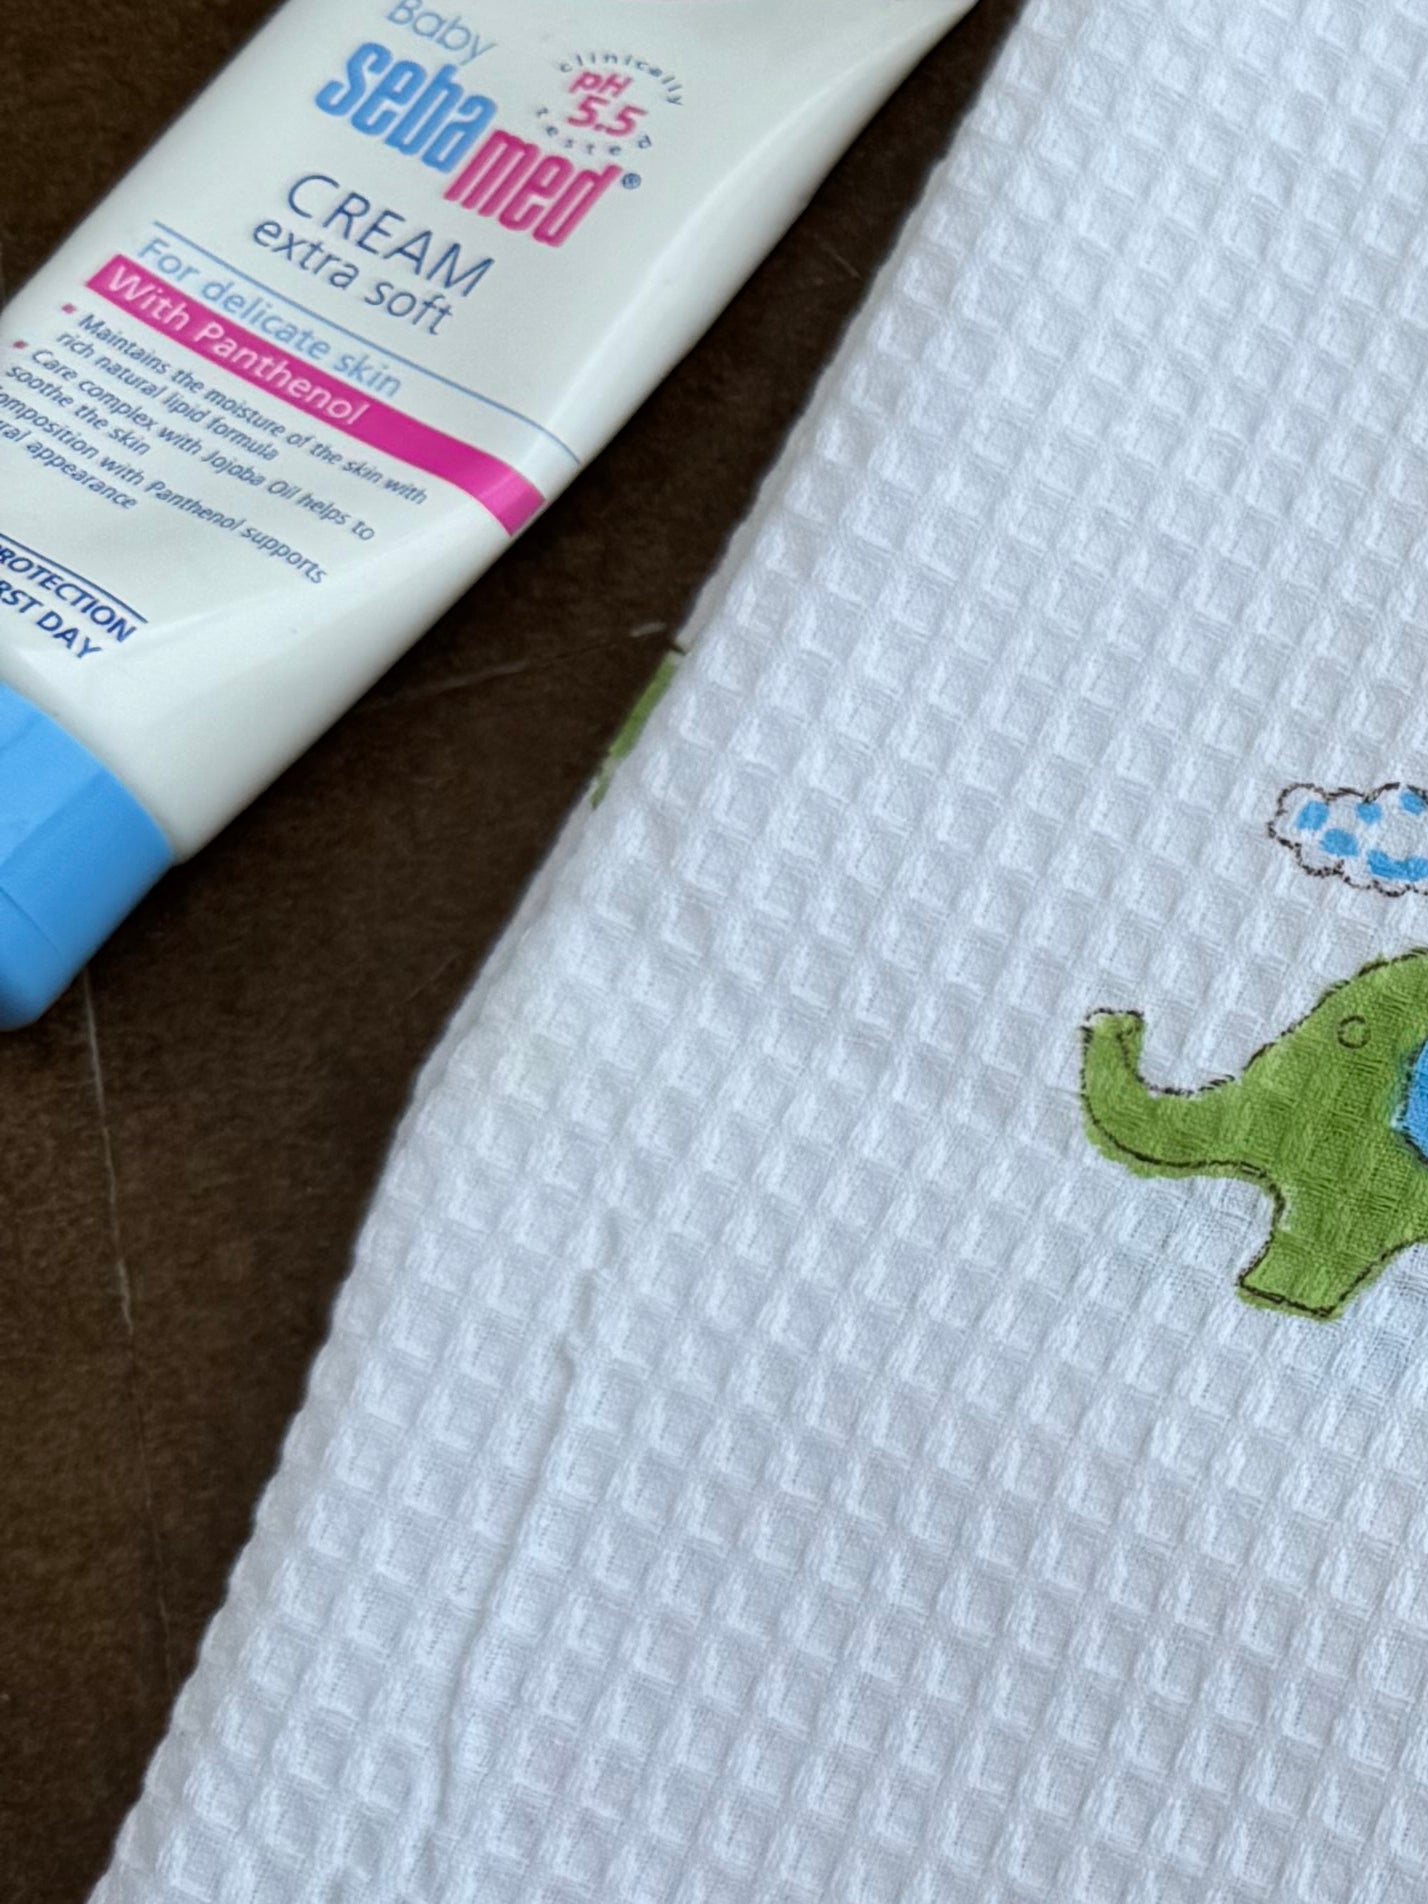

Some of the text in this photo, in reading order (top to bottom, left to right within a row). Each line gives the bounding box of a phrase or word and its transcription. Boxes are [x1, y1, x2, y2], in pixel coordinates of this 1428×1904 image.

[536, 107, 652, 155] tested
[559, 52, 683, 106] clinically
[567, 96, 649, 136] 5.5
[568, 71, 634, 98] pH
[253, 213, 455, 337] extra soft
[287, 173, 496, 298] CREAM
[108, 265, 370, 425] With Panthenol
[137, 237, 402, 399] For delicate skin
[6, 365, 151, 456] soothe the skin
[32, 349, 375, 541] Care complex with Jojoba Oil helps to
[57, 332, 279, 461] rich natural lipid formula
[79, 314, 427, 505] Maintains the moisture of the skin with
[0, 386, 328, 584] omposition with Panthenol supports
[27, 441, 137, 510] appearance
[0, 545, 138, 643] ROTECTION
[36, 610, 102, 659] DAY
